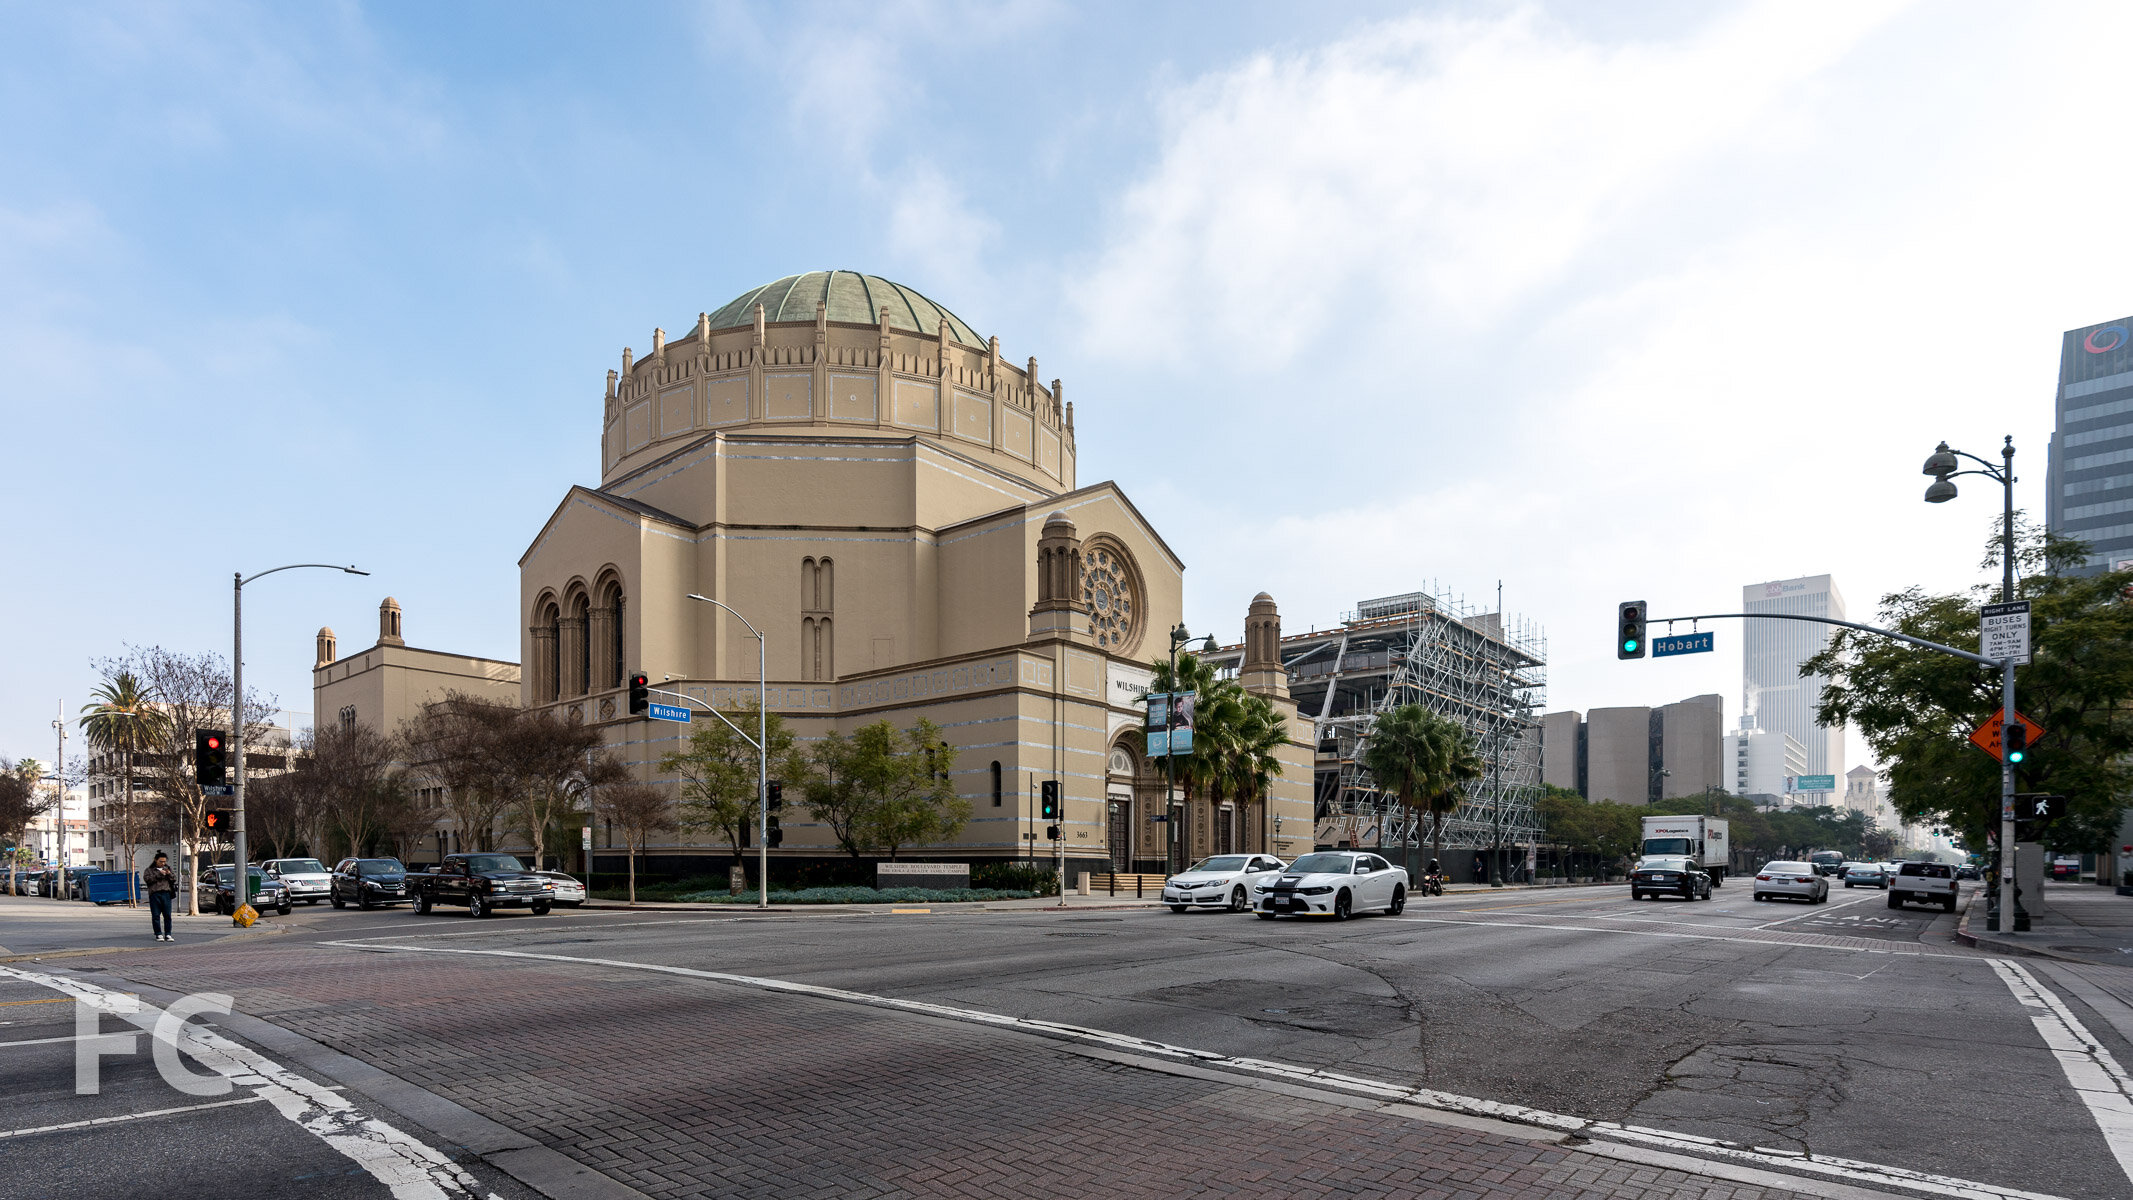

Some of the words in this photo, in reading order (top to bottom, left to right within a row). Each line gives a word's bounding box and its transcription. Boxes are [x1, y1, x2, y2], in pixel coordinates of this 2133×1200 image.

[1783, 583, 1806, 591] Bank
[1988, 616, 2022, 625] BUSES
[1992, 631, 2017, 640] ONLY
[1657, 637, 1708, 652] Hobart
[1116, 680, 1149, 693] WILSHIRE
[653, 706, 687, 718] Wilshire
